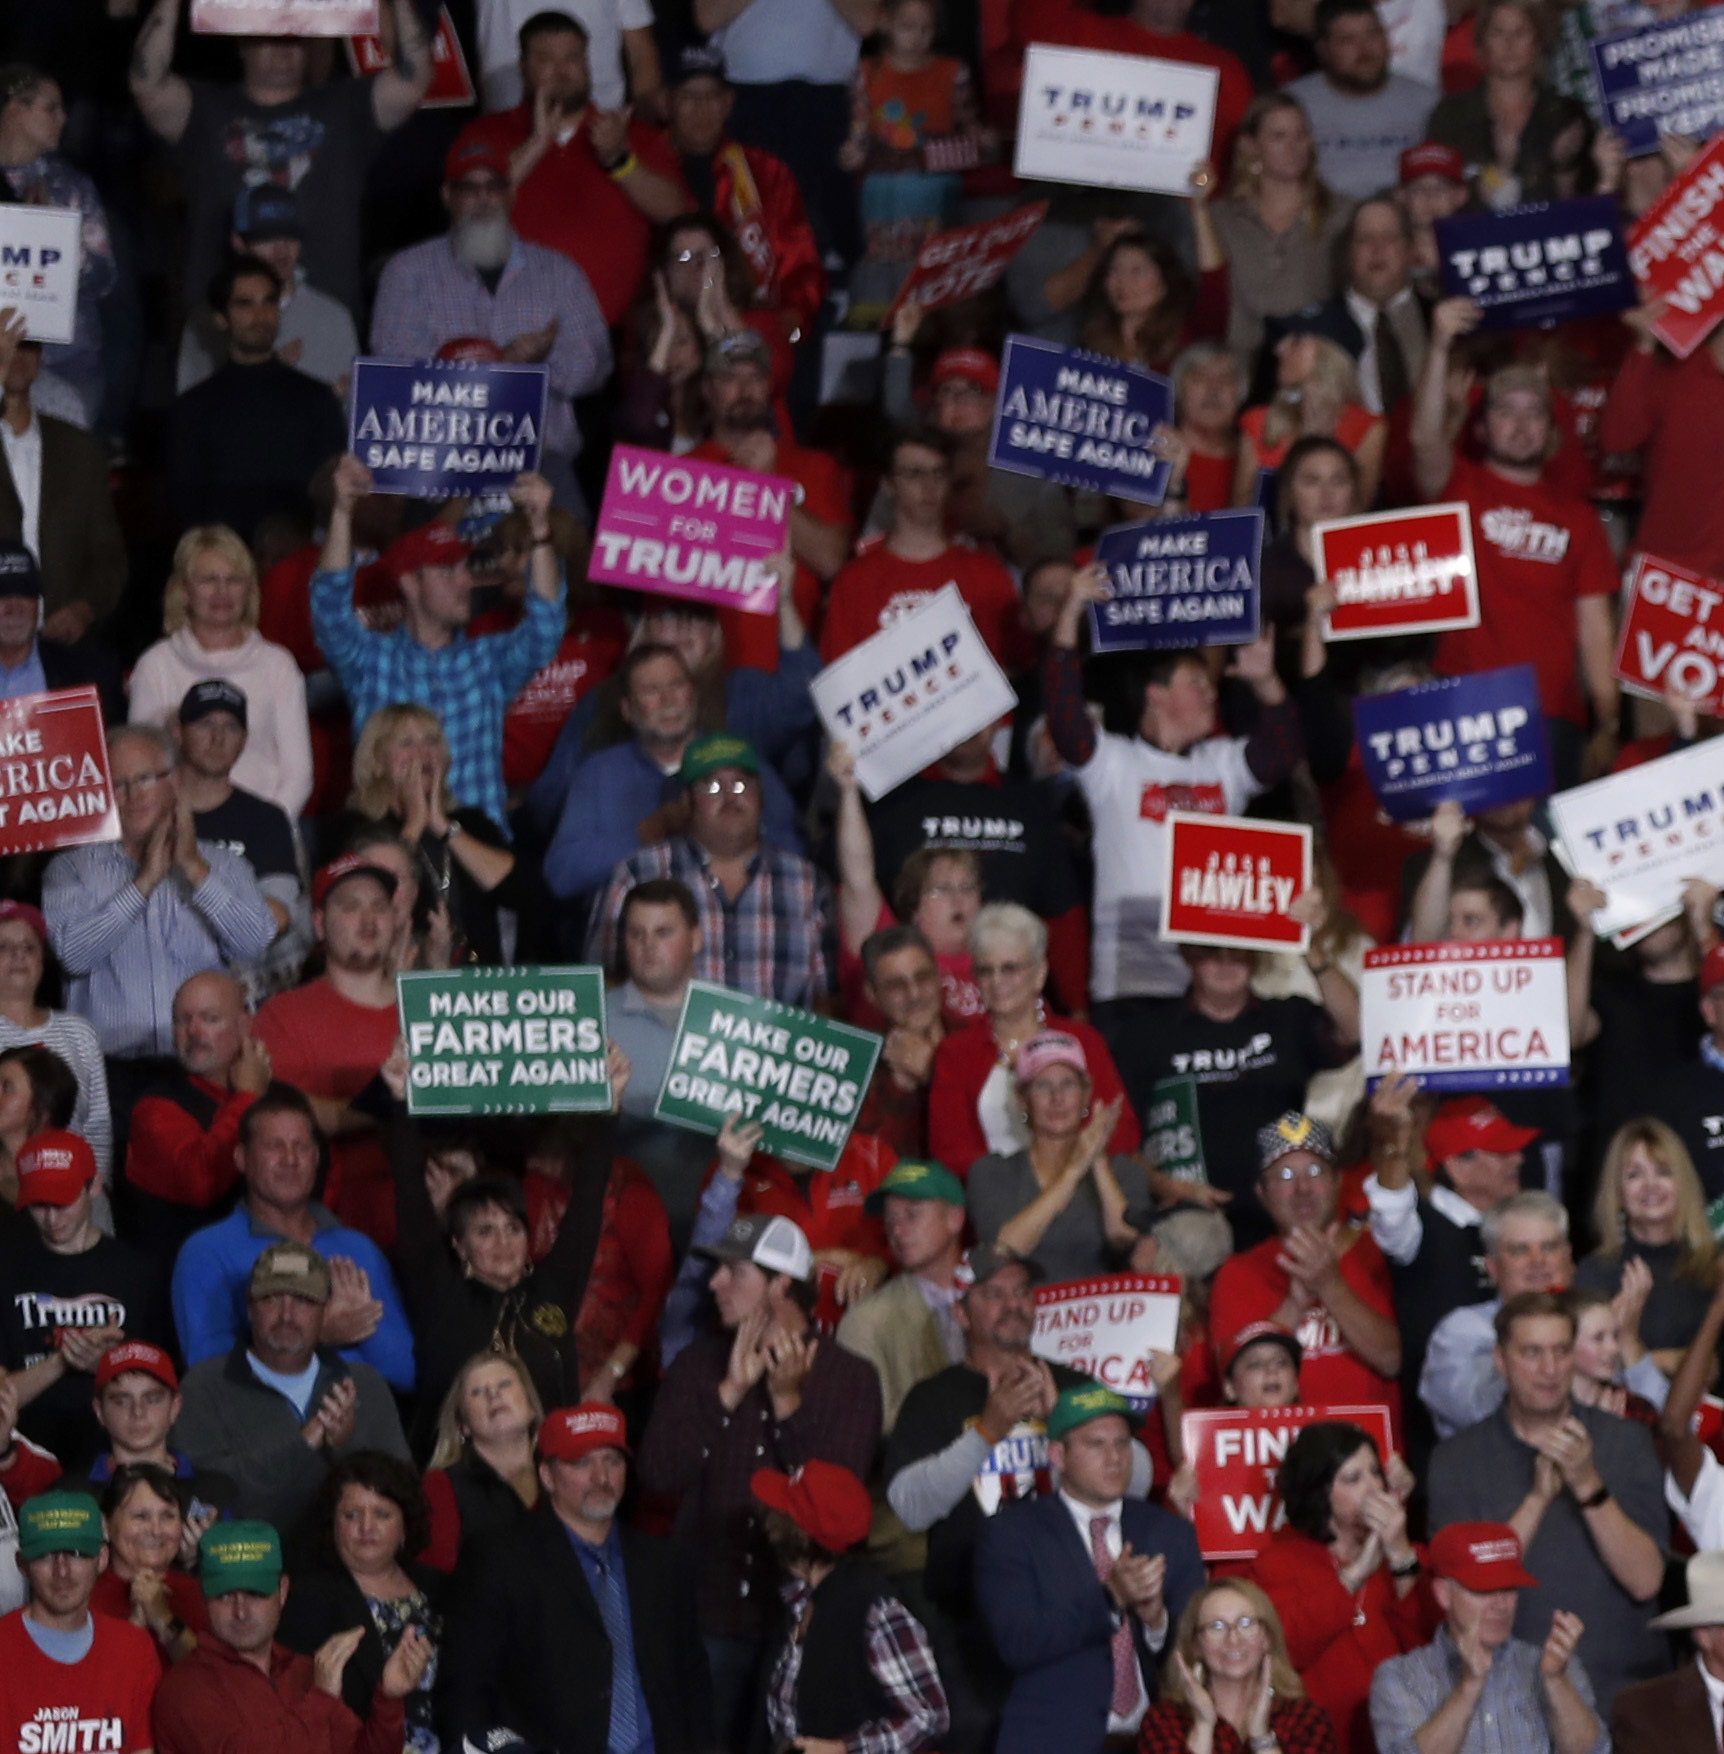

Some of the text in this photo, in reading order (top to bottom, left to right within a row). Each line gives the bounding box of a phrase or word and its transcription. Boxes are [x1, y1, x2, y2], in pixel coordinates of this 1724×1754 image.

[1041, 84, 1197, 121] TRUMP
[1450, 230, 1612, 278] TRUMP
[413, 382, 489, 408] MAKE
[1058, 368, 1129, 402] MAKE
[357, 411, 538, 447] AMERICA
[1004, 386, 1152, 443] AMERIC
[368, 447, 526, 473] SAFE AGAIN
[1011, 427, 1155, 478] SAFE AGAIN
[619, 458, 786, 523] WOMEN
[668, 515, 717, 540] FOR
[1138, 531, 1209, 557] MAKE
[599, 532, 779, 595] TRUMP
[1106, 557, 1252, 596] MERICA
[1107, 594, 1245, 626] SAFE AGAIN
[1641, 569, 1722, 625] GET
[837, 632, 962, 728] TRUMP
[1369, 705, 1529, 758] TRUMP
[1388, 735, 1518, 779] PENCE
[16, 793, 107, 825] AGAIN
[924, 816, 1023, 840] TRUMP
[1180, 866, 1296, 914] HAWLEY
[429, 989, 577, 1015] MAKE OUR
[1387, 969, 1533, 998] STAND UP
[1436, 1002, 1482, 1021] FOR
[409, 1019, 600, 1056] FARMERS
[710, 1011, 851, 1074] MAKE OUR
[1378, 1028, 1549, 1067] AMERICA
[411, 1058, 606, 1087] GREAT AGAIN!
[679, 1037, 859, 1116] FARMERS
[668, 1073, 849, 1143] GREAT AGAIN!
[1106, 1301, 1146, 1327] UP
[34, 1706, 79, 1723] JASON
[20, 1718, 123, 1754] SMITH
